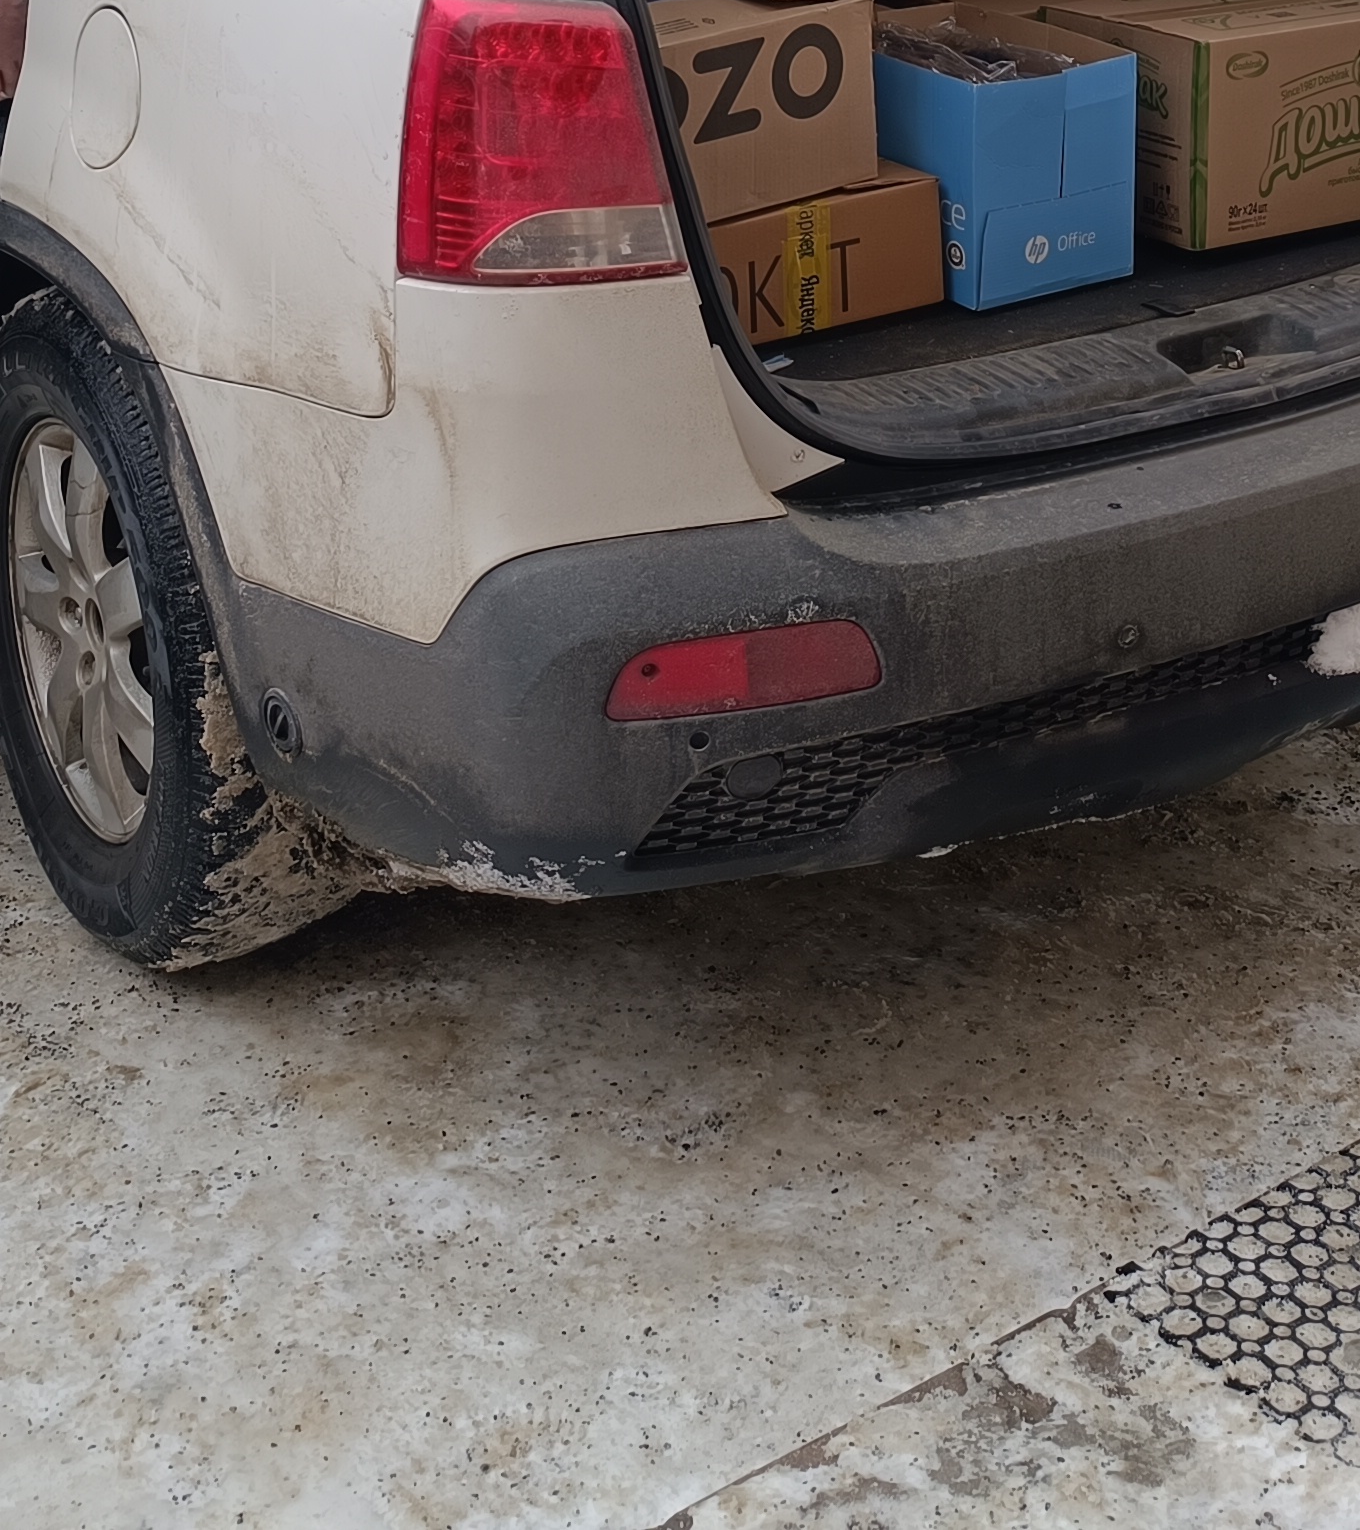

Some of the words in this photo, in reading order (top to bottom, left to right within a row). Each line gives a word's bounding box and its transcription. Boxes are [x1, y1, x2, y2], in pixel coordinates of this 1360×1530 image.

[1318, 68, 1350, 85] Doshirak
[1027, 236, 1047, 264] hp
[1058, 231, 1096, 251] Office
